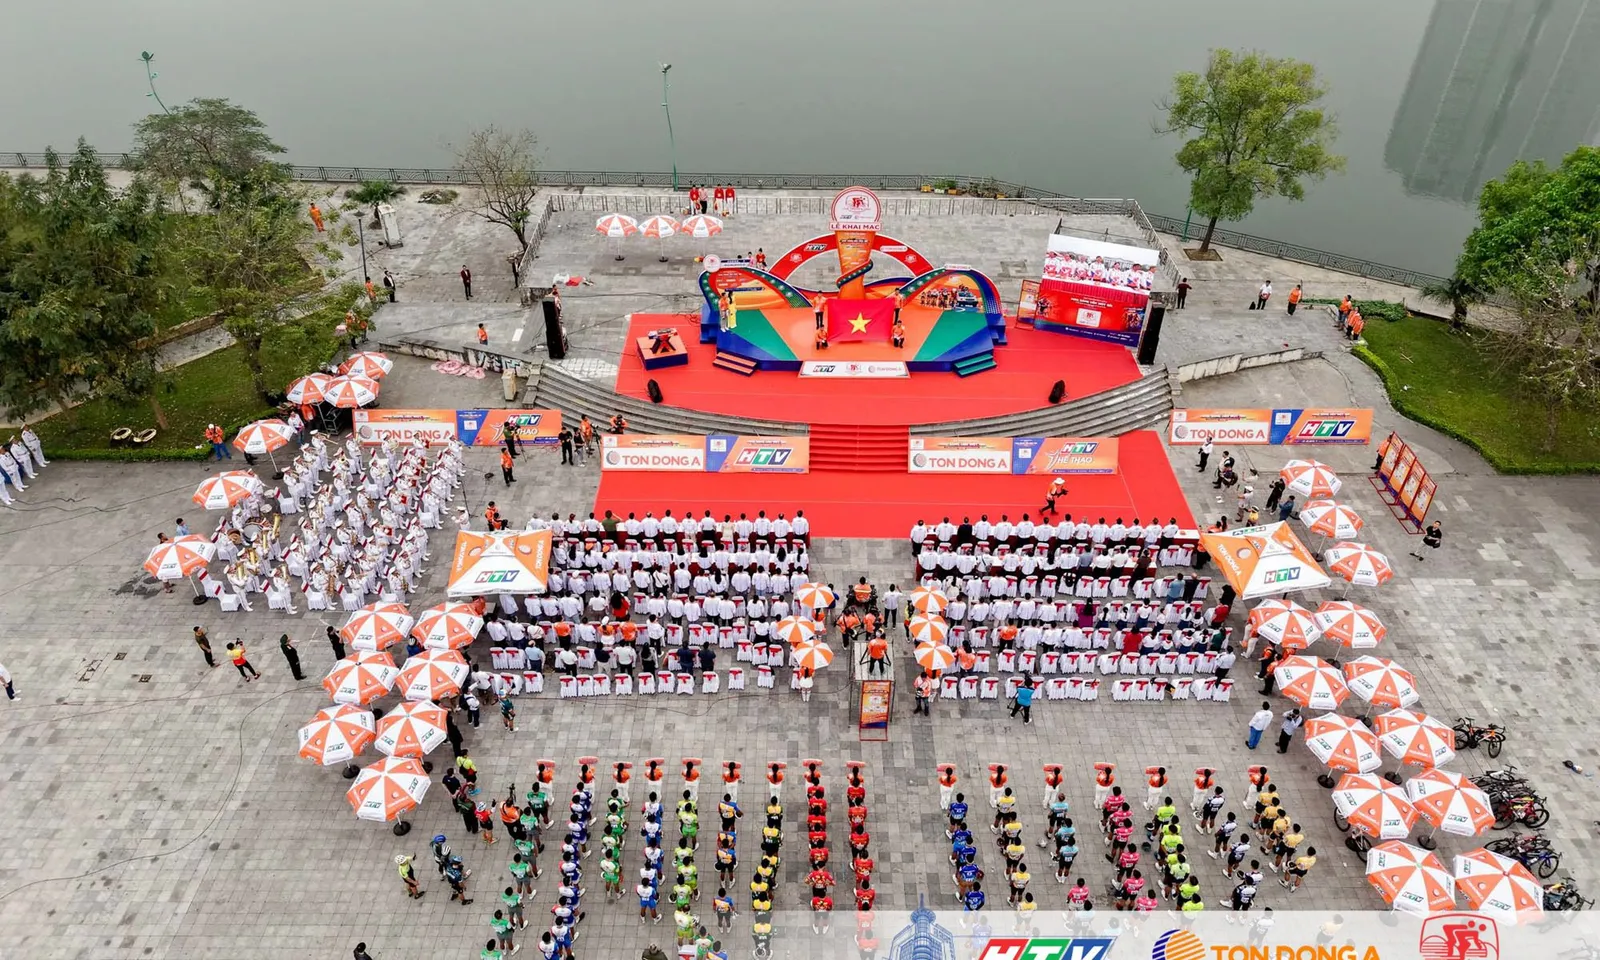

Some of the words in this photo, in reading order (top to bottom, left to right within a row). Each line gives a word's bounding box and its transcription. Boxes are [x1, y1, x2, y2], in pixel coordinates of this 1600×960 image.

[506, 414, 542, 426] HTV
[1190, 429, 1216, 438] TON
[1218, 429, 1254, 438] DONG
[1255, 429, 1265, 438] A
[1298, 420, 1356, 438] HTV
[1060, 442, 1099, 454] HTV
[622, 456, 649, 465] TON
[652, 456, 690, 466] DONG
[691, 456, 700, 466] A
[734, 448, 794, 465] HTV
[1071, 456, 1093, 464] THAO
[929, 458, 956, 468] TON
[958, 458, 995, 468] DONG
[997, 458, 1008, 468] A
[474, 570, 520, 583] HTV
[1264, 567, 1300, 584] HTV
